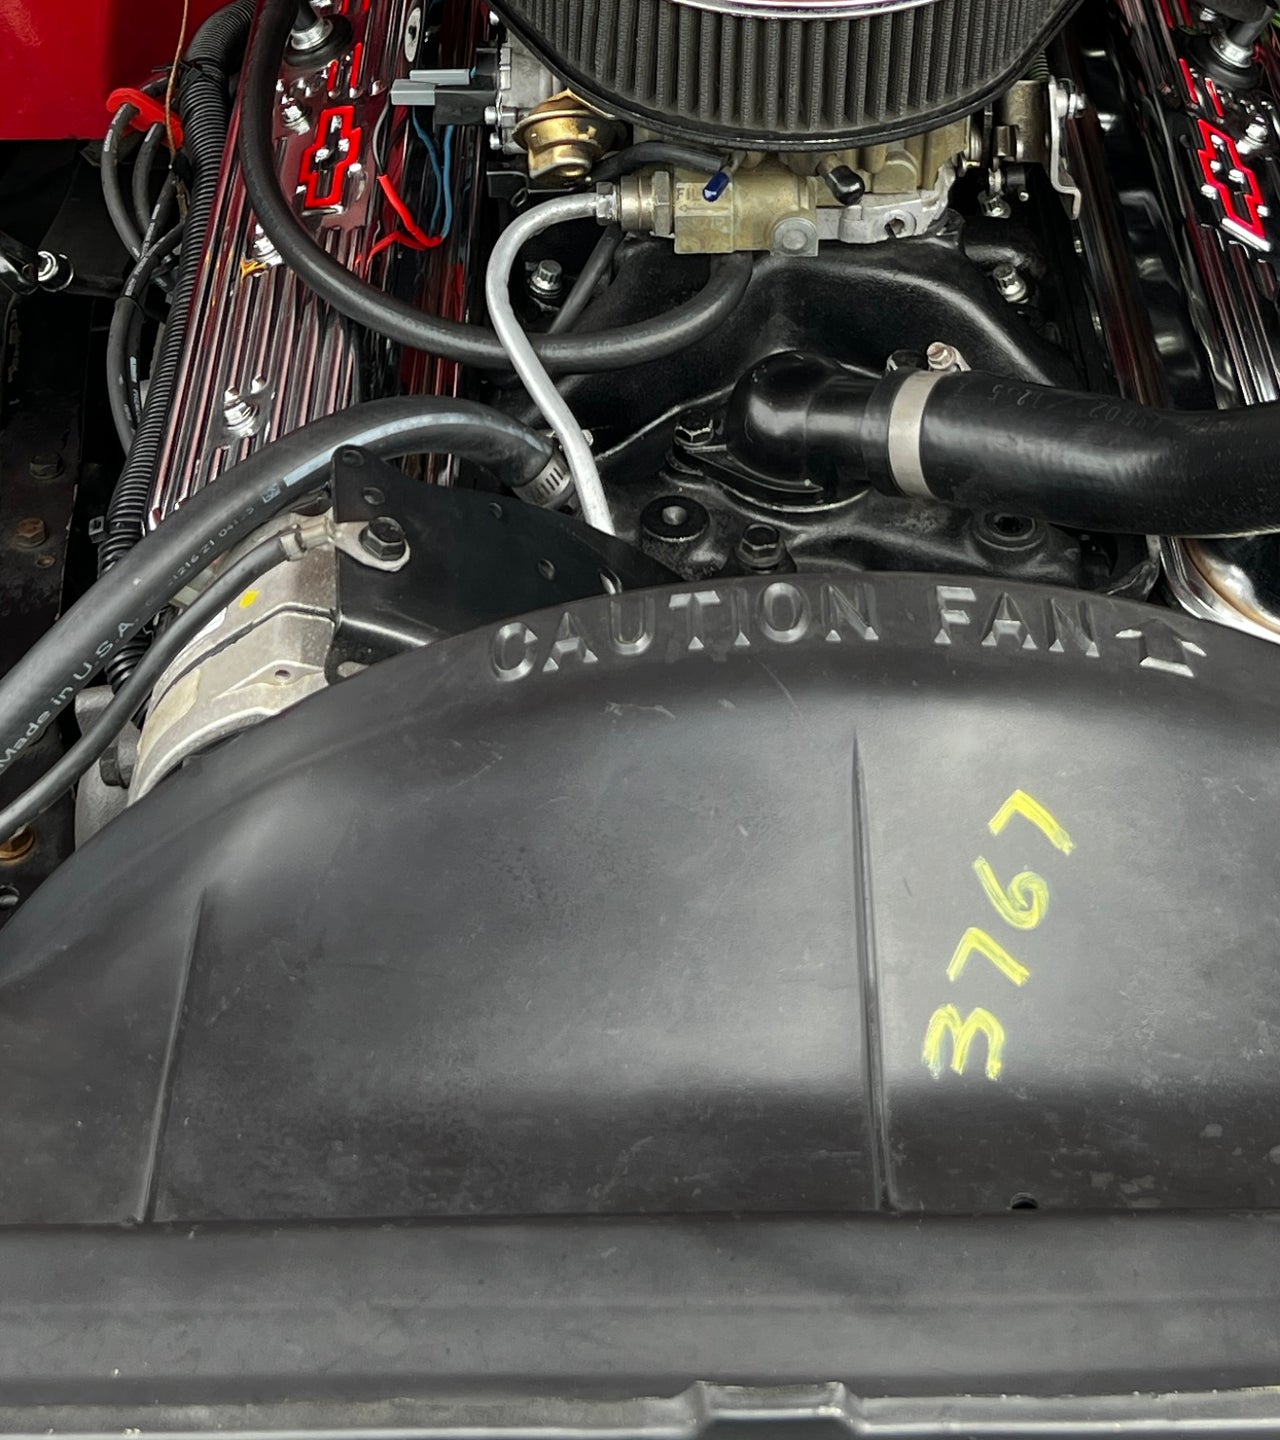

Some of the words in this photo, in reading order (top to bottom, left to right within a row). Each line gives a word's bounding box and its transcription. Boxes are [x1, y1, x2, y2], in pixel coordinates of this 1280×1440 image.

[51, 685, 74, 707] in
[73, 617, 139, 681] U.S.A.
[489, 580, 881, 682] CAUTION
[928, 584, 1101, 658] FAN
[921, 788, 1078, 1082] 3767
